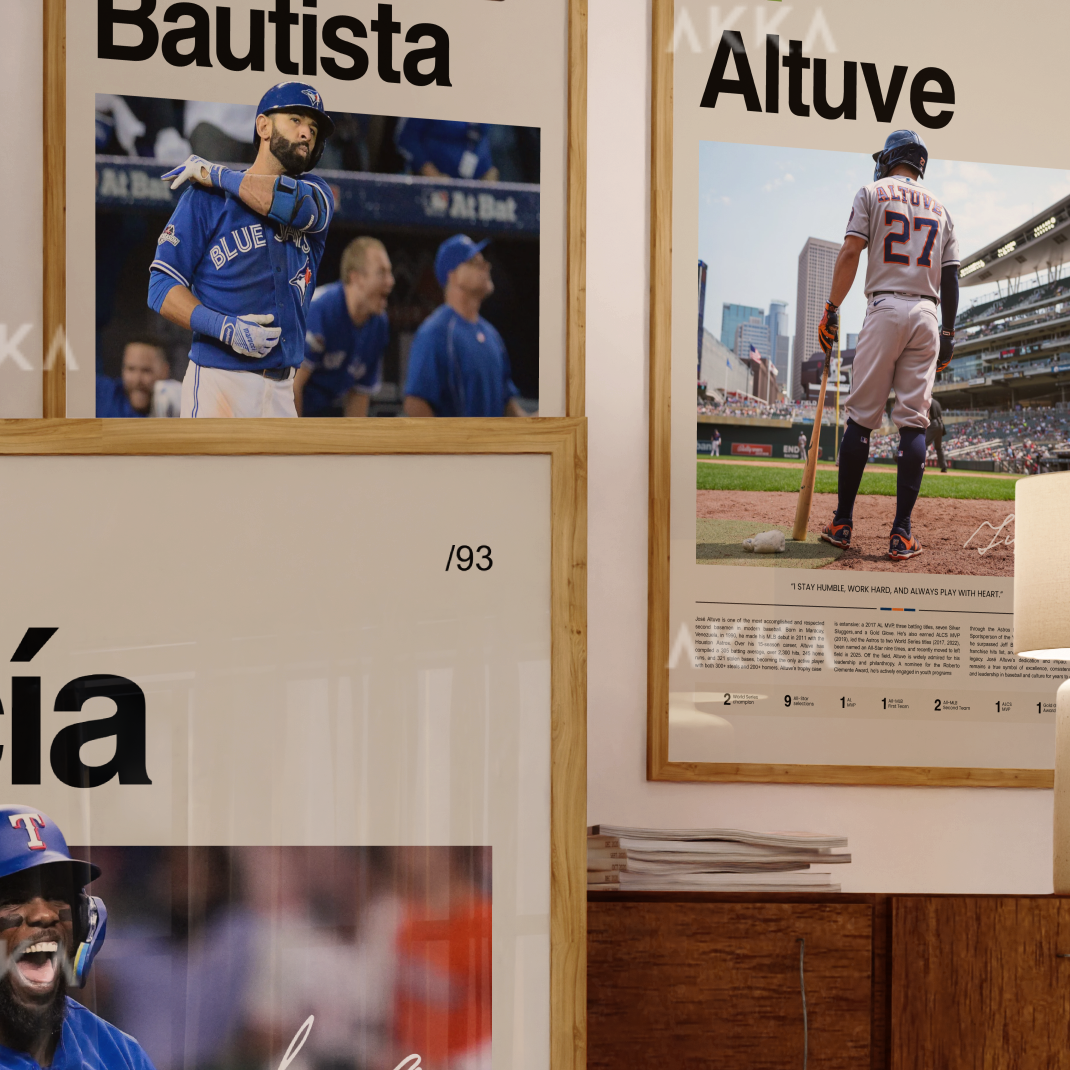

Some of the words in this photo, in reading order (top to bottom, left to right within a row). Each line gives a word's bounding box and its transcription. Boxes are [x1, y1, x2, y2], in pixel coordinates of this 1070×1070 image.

[97, 0, 452, 87] Bautista
[699, 29, 956, 130] Altuve
[876, 185, 943, 217] ALTUVE
[883, 209, 940, 268] 27
[209, 224, 267, 271] BLUE
[783, 445, 800, 453] END
[445, 544, 494, 571] /93
[790, 582, 795, 590] “I
[797, 582, 815, 590] STAY
[816, 583, 846, 593] HUMBLE,
[870, 586, 892, 594] HARD,
[893, 586, 908, 594] AND
[910, 587, 938, 595] ALWAYS
[940, 588, 956, 596] PLAY
[723, 693, 731, 705] 2
[784, 694, 792, 707] 9
[840, 696, 845, 708] 1
[882, 697, 887, 709] 1
[934, 699, 941, 711] 2
[995, 701, 1000, 713] 1
[1036, 702, 1041, 714] 1
[8, 813, 47, 850] T
